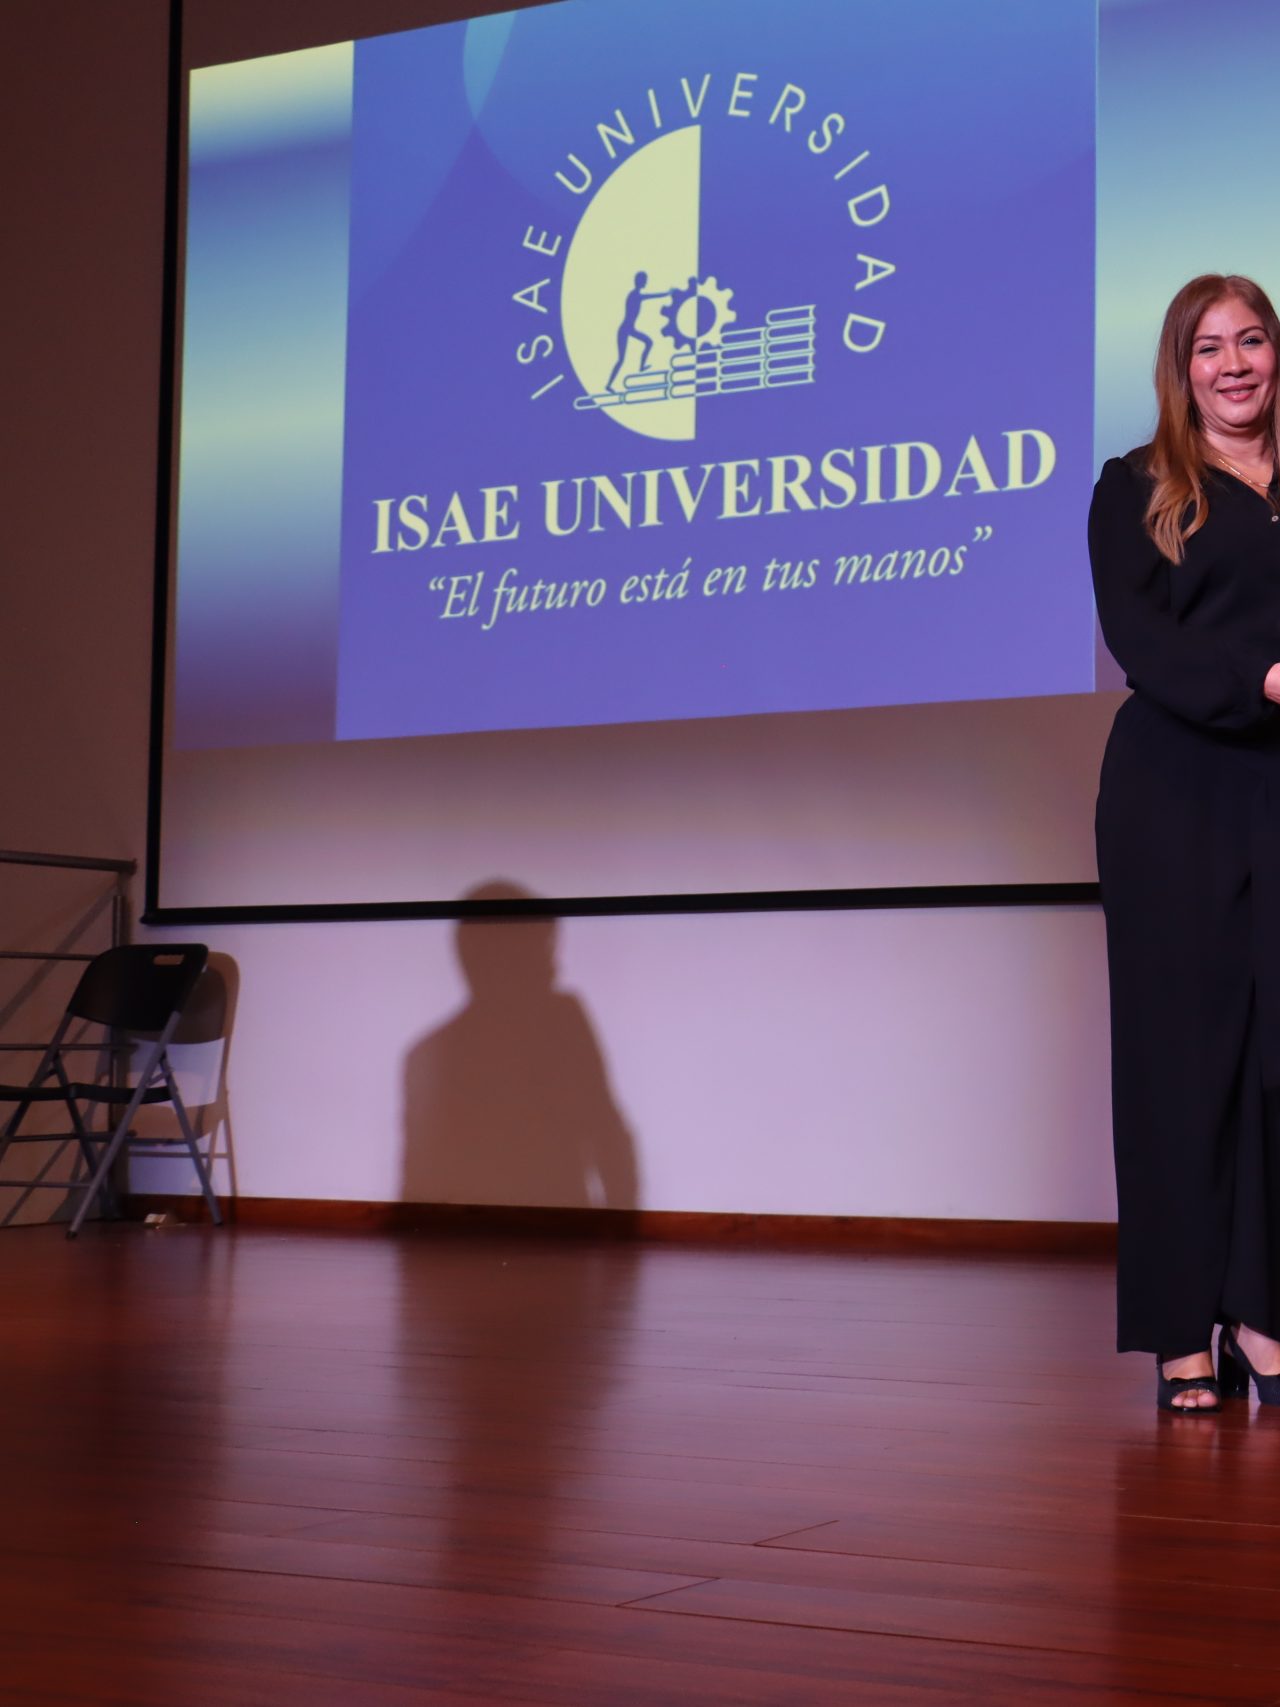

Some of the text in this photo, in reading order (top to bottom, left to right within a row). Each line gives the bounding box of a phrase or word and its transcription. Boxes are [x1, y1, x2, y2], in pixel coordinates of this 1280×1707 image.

[511, 71, 897, 401] ISAE UNIVERSIDAD
[370, 427, 1058, 555] ISAE UNIVERSIDAD
[479, 566, 608, 631] futuro
[619, 557, 694, 605] está
[702, 565, 748, 598] en
[761, 557, 821, 593] tus
